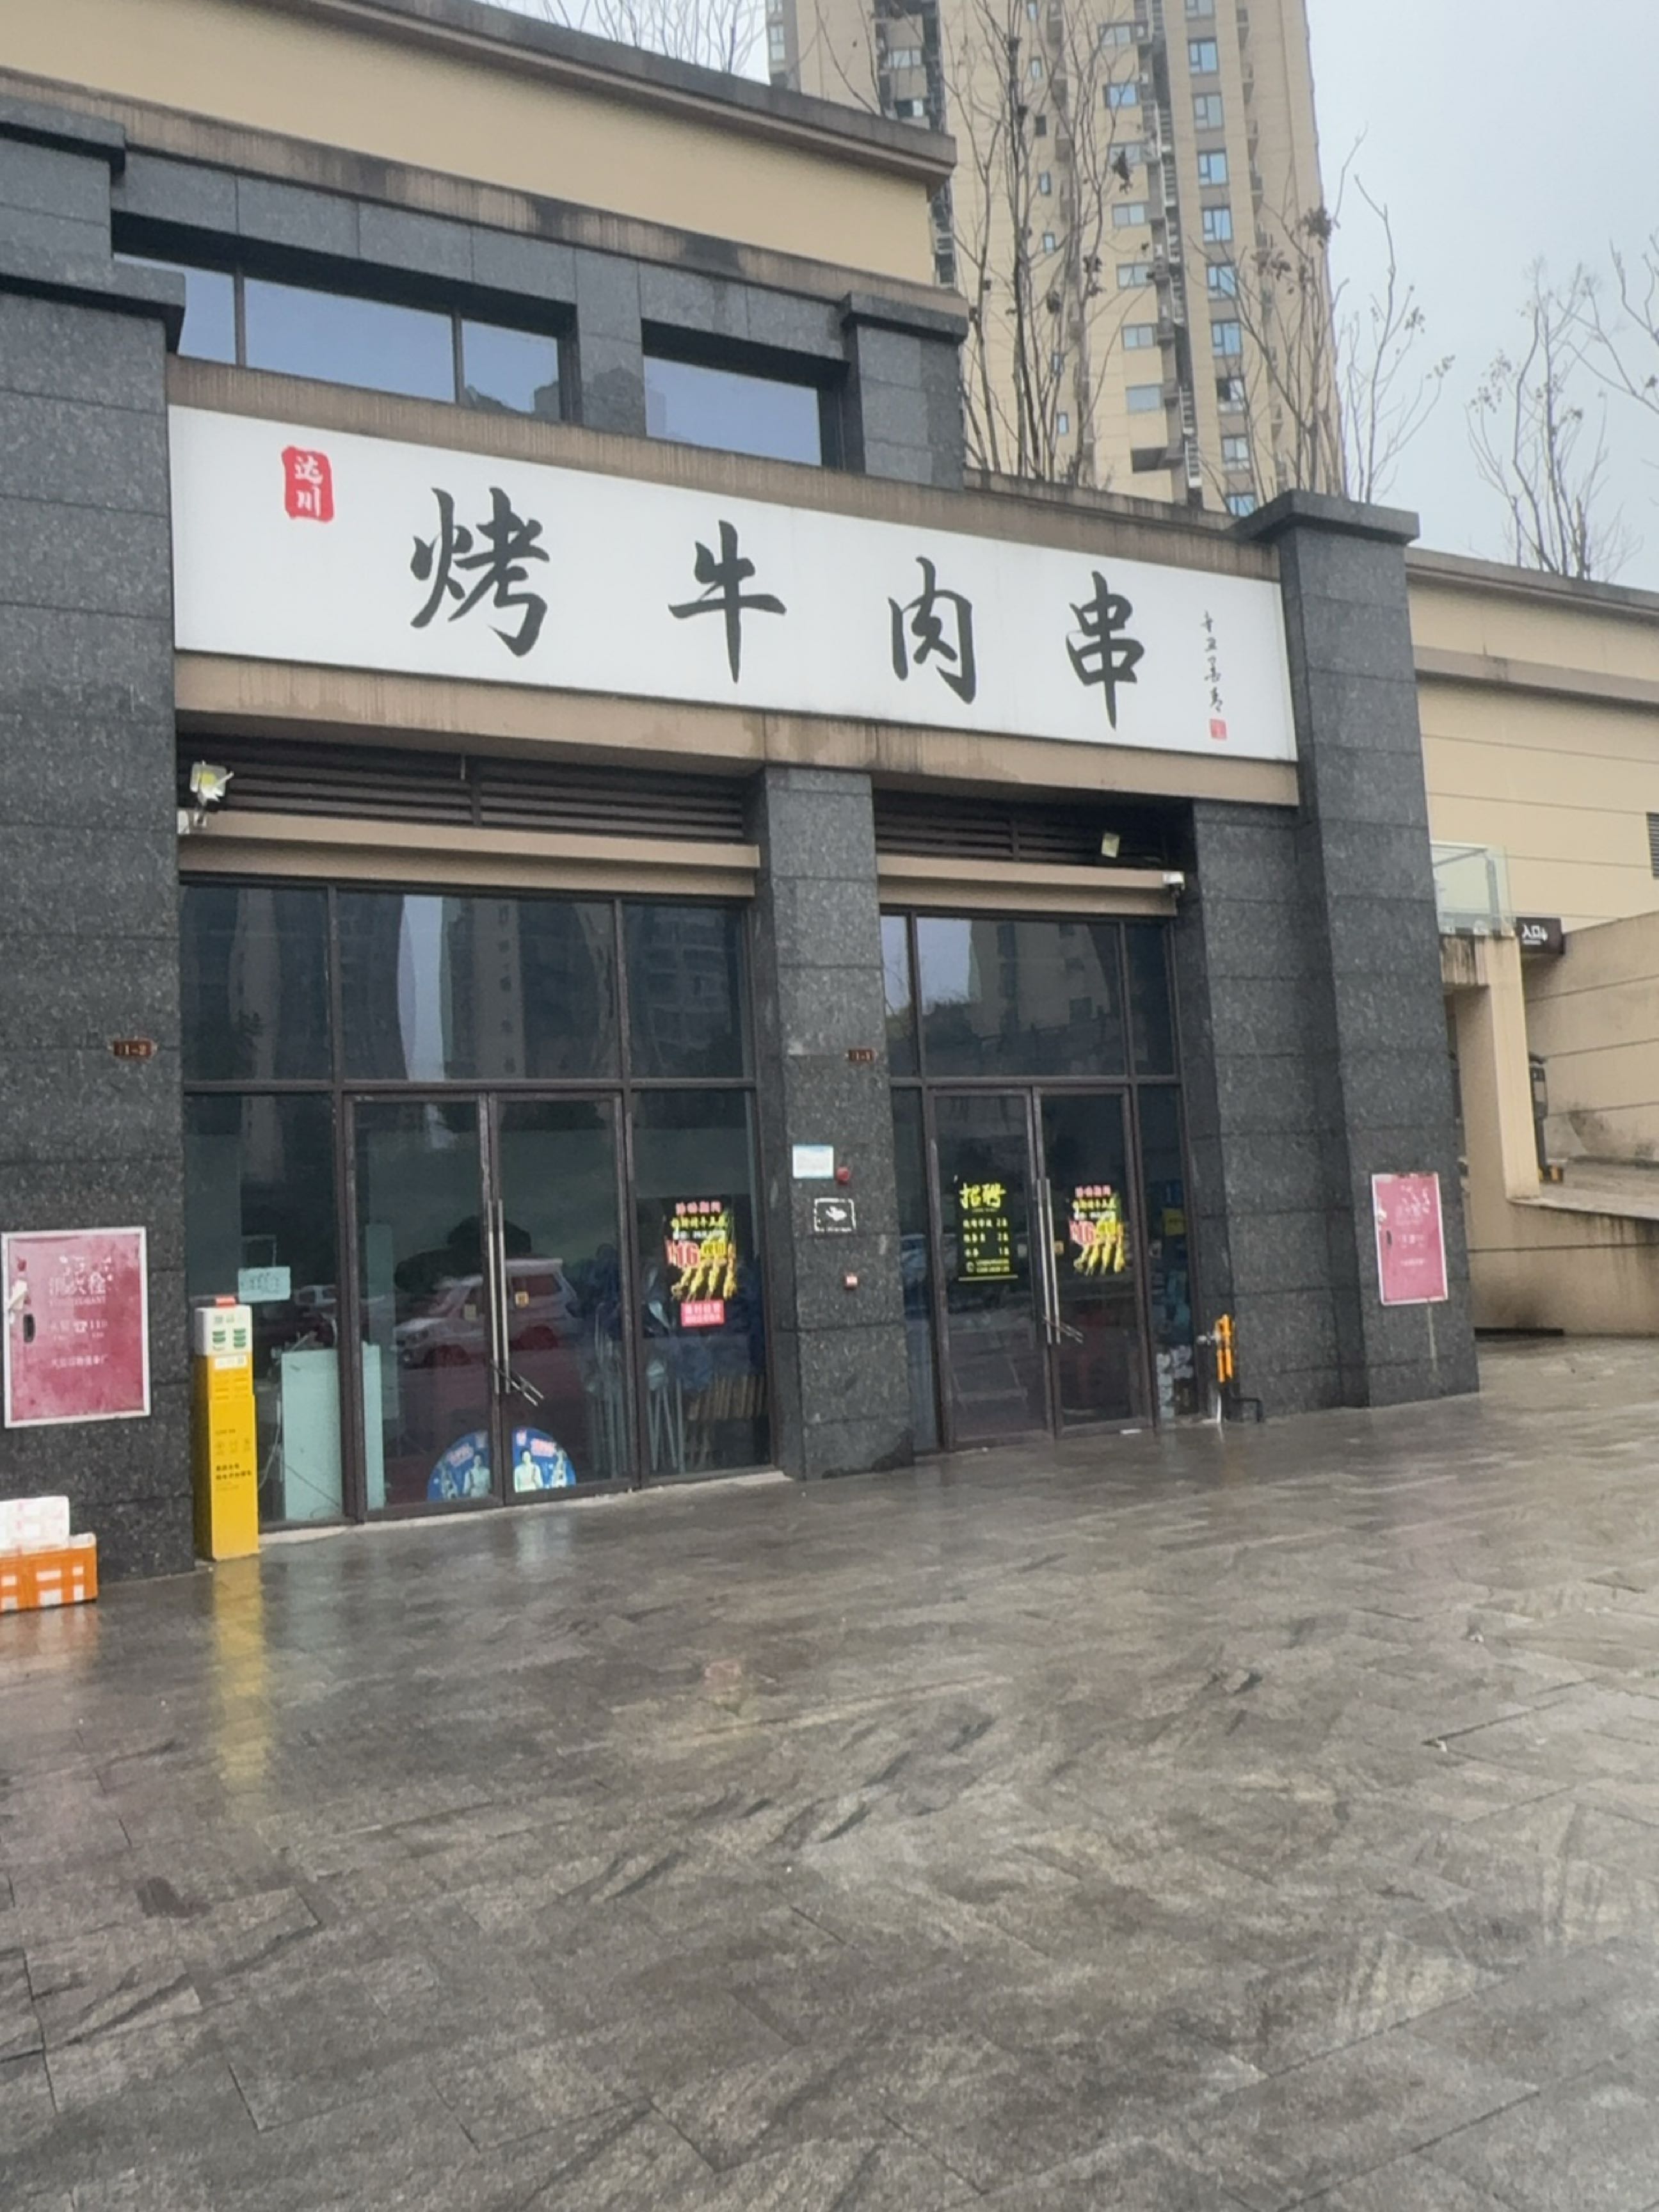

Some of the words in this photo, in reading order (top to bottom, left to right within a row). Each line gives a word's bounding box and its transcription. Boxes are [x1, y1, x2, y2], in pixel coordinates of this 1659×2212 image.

[294, 454, 323, 517] 达川
[410, 486, 1144, 730] 烤牛肉串
